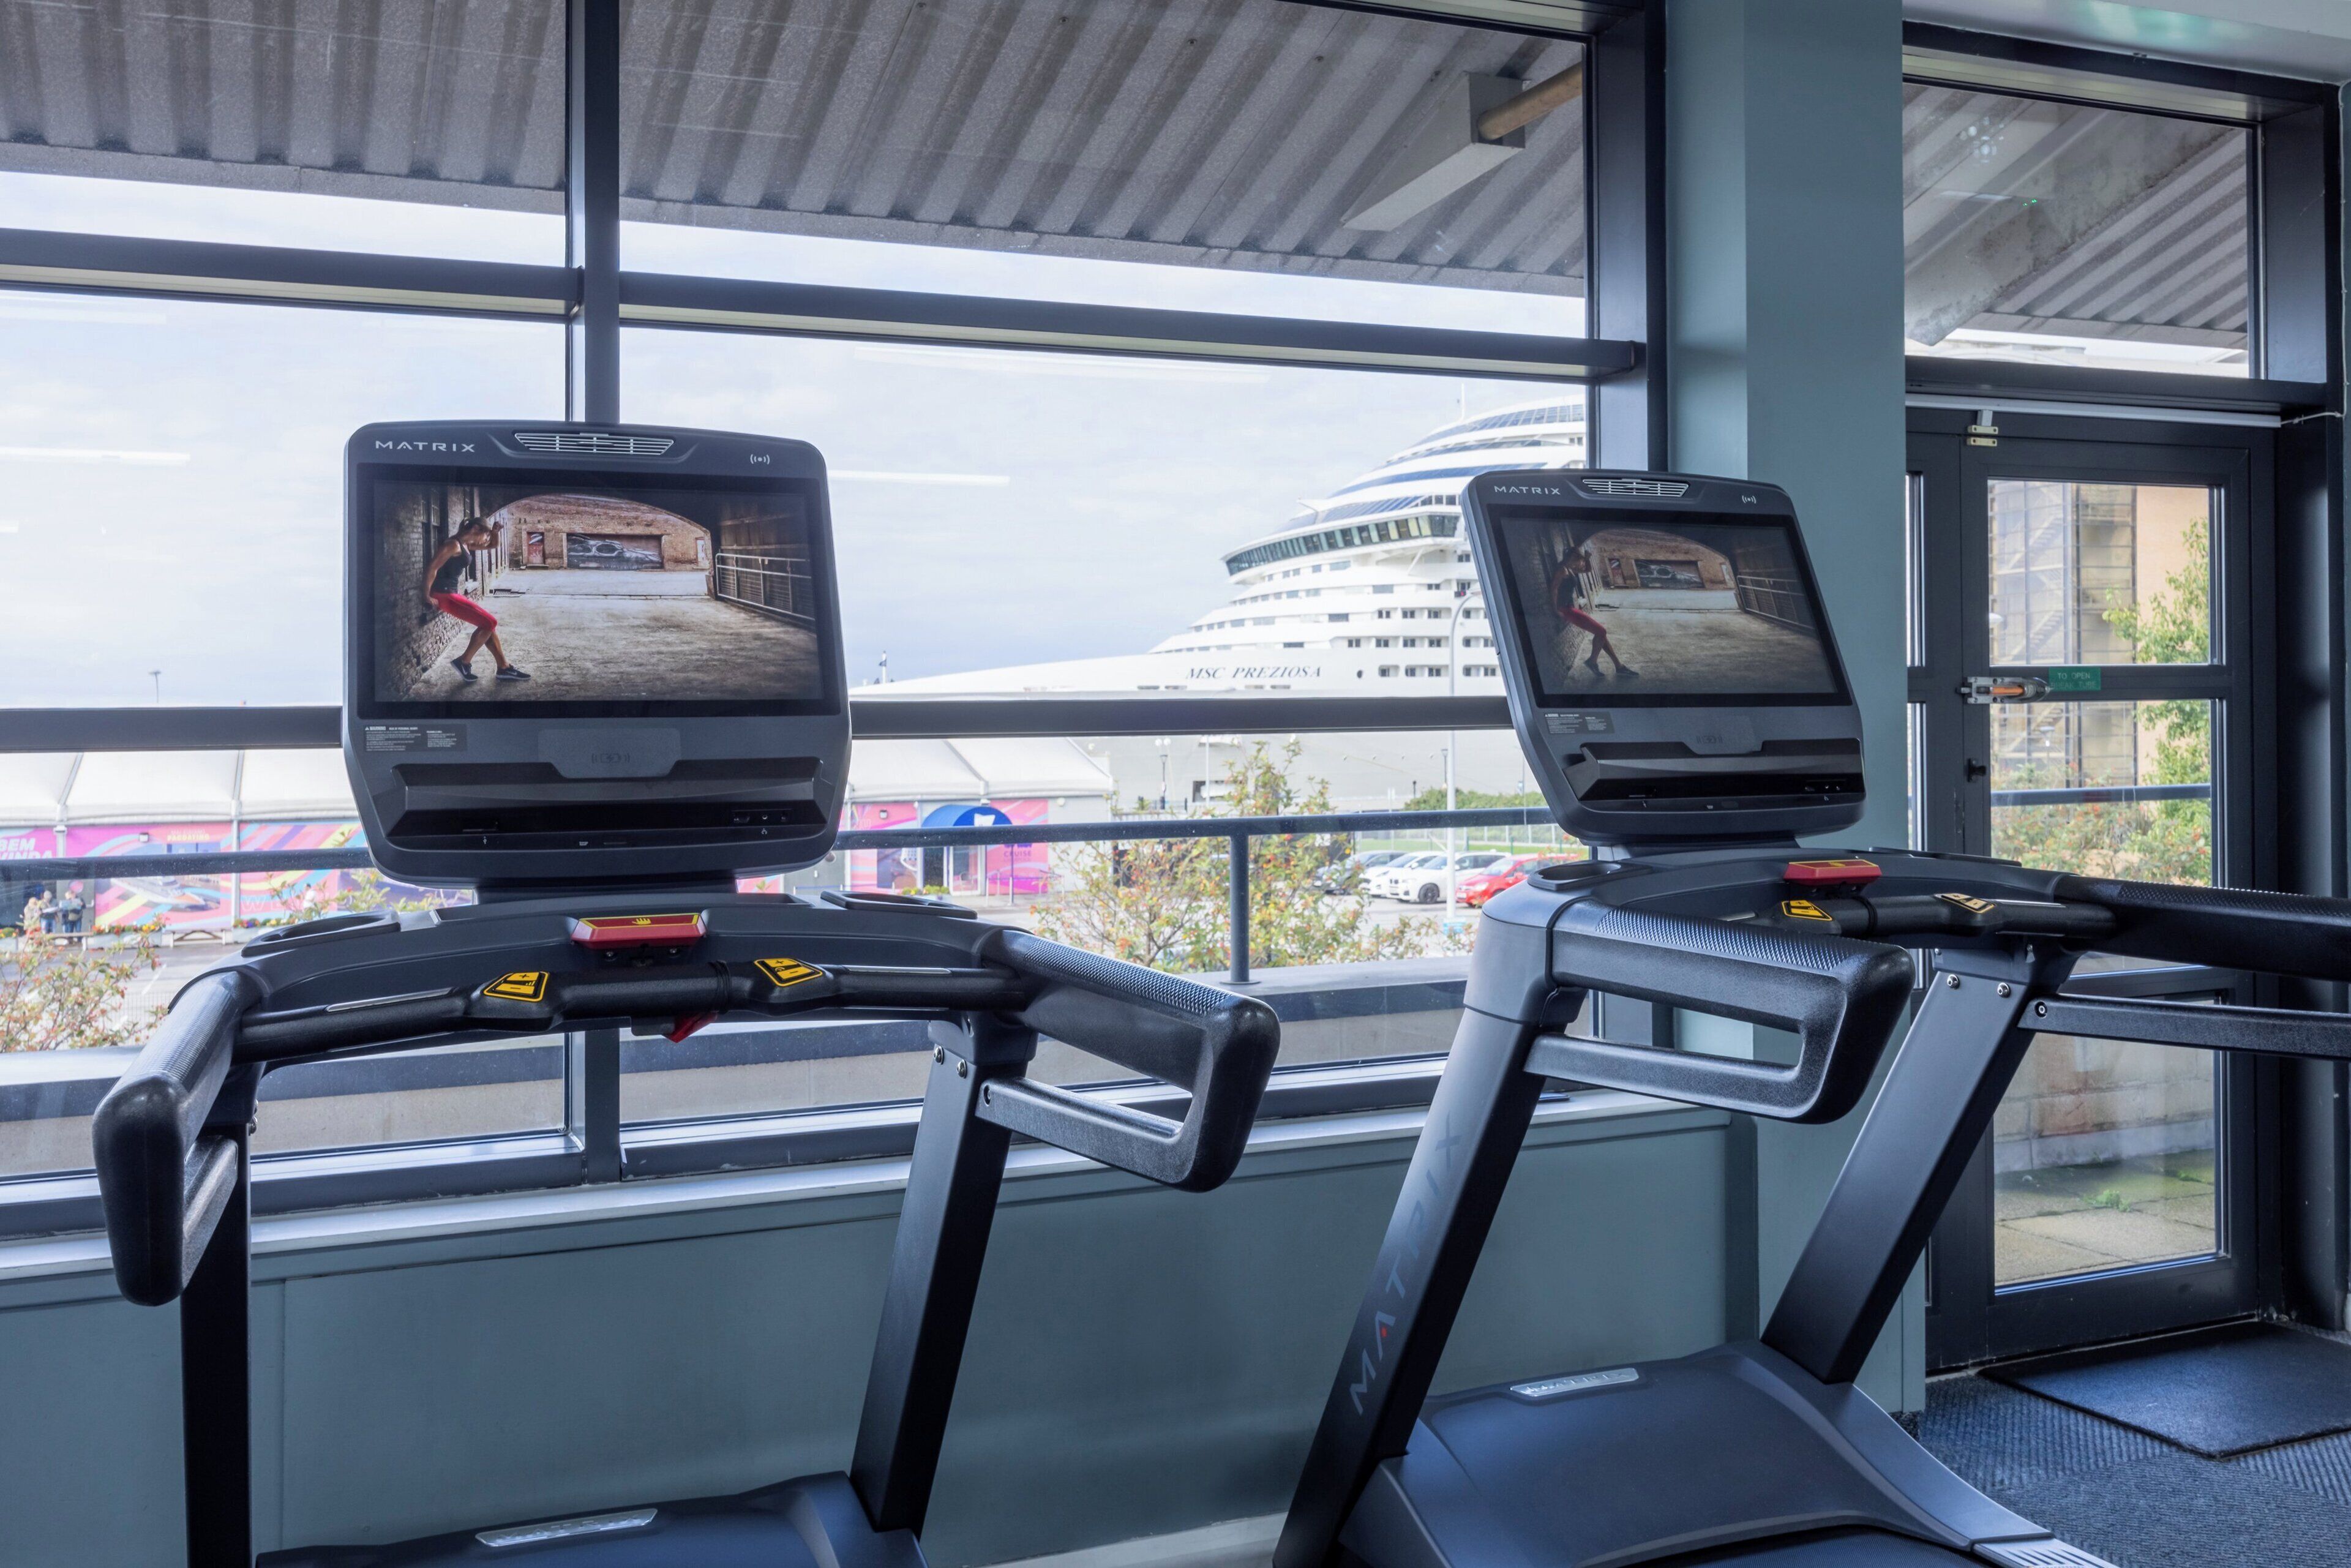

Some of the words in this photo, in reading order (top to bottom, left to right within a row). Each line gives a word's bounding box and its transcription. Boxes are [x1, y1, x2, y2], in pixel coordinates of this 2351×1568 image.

[375, 440, 475, 452] MATRIX
[1494, 486, 1561, 495] MATRIX
[1186, 667, 1226, 679] MSC
[1232, 665, 1322, 678] PREZIOSA
[1350, 1109, 1461, 1416] MATRIX
